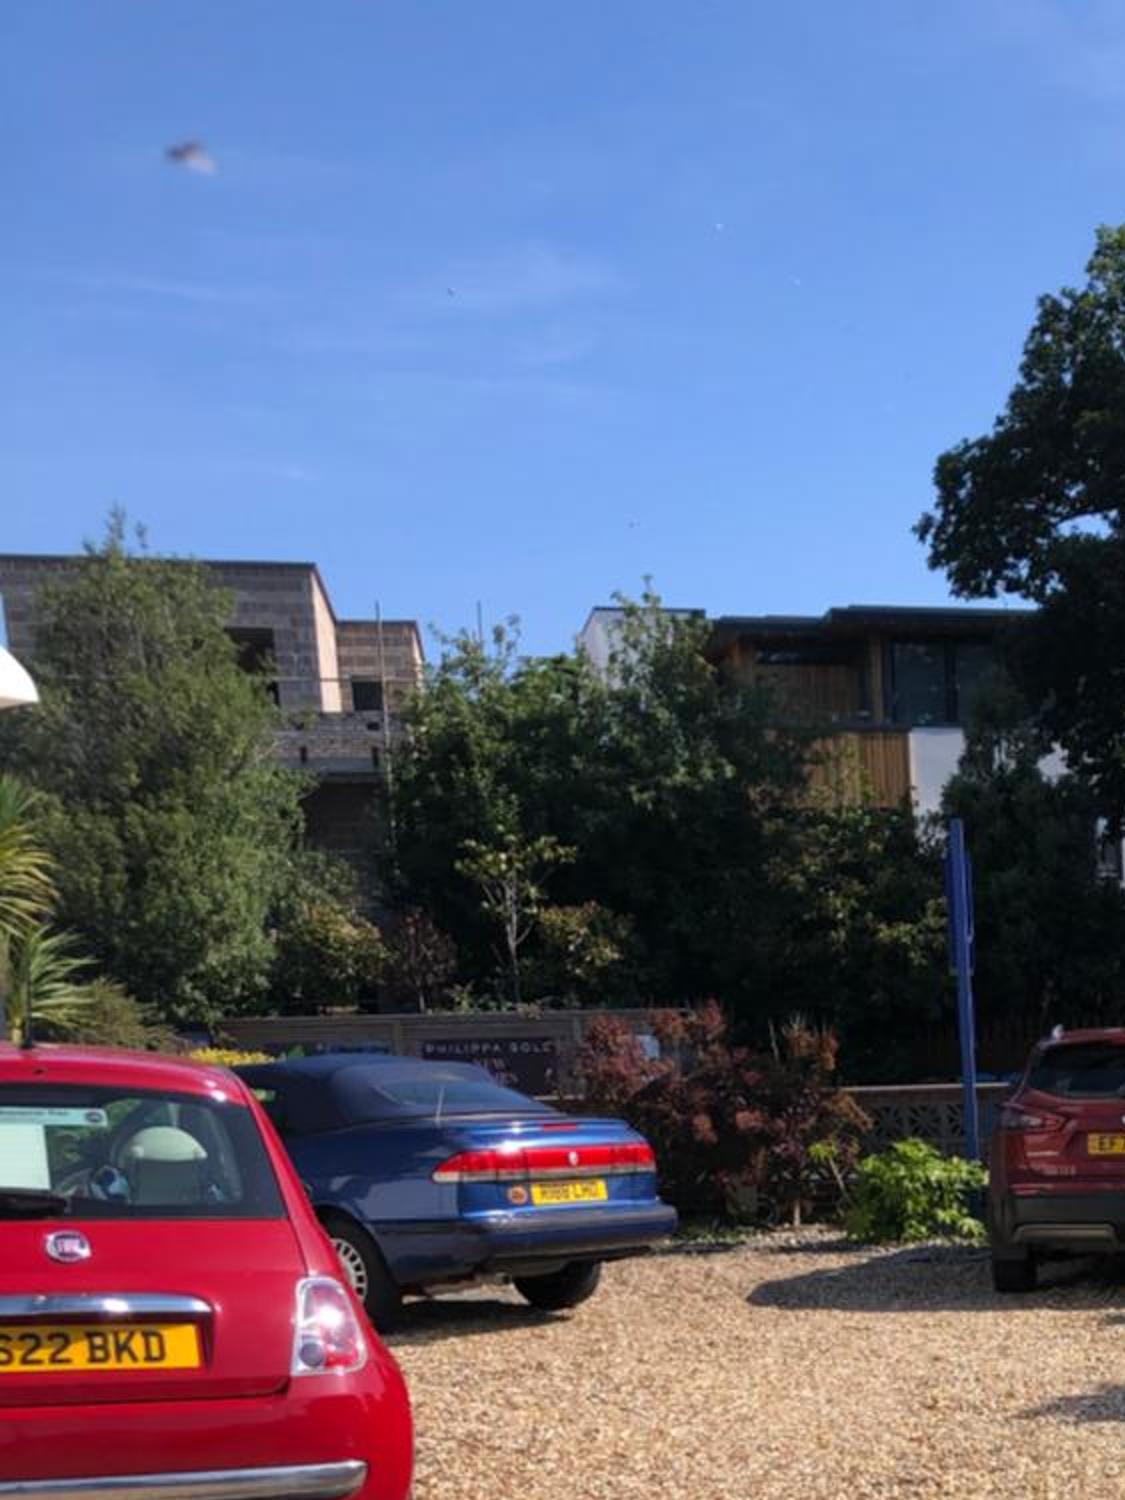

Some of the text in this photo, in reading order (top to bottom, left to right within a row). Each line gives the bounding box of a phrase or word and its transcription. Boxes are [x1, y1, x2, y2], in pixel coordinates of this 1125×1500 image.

[425, 1042, 500, 1054] PHILIPPA
[0, 1329, 168, 1365] S22 BKD
